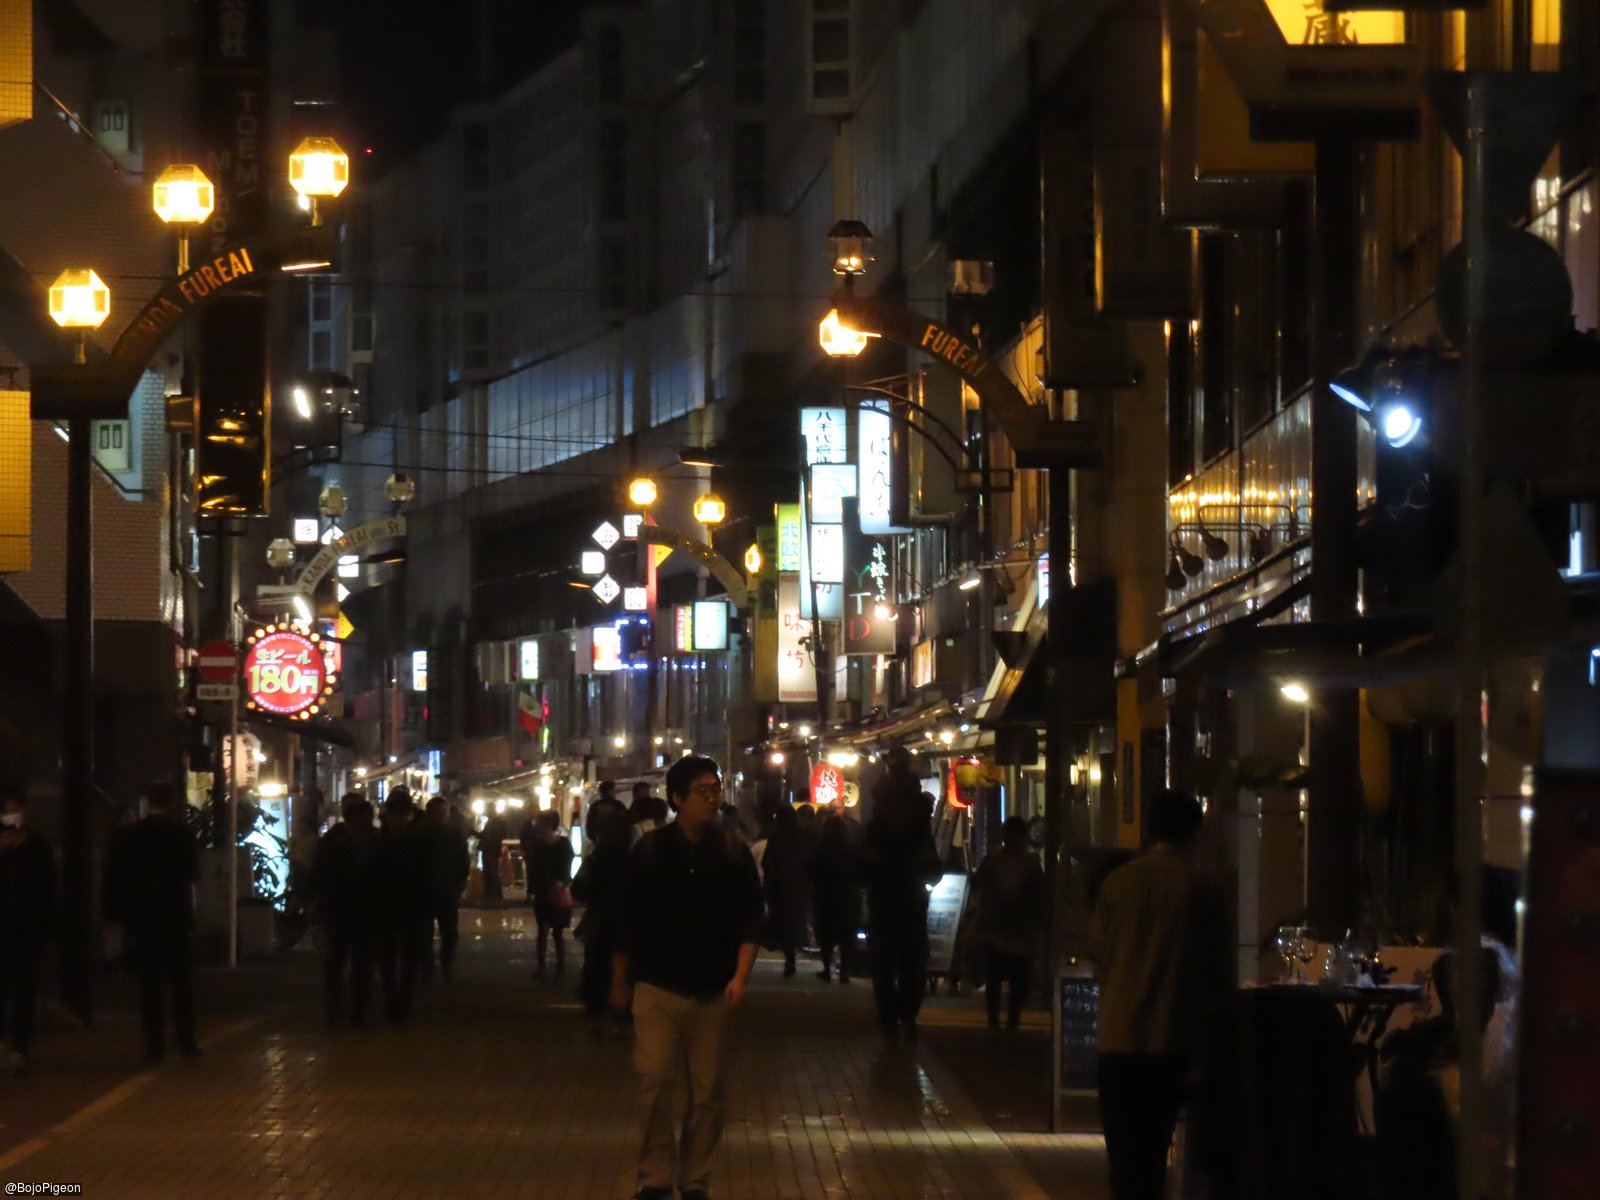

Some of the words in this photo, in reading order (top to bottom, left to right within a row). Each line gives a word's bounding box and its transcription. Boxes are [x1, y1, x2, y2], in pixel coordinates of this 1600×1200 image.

[178, 247, 254, 304] FUREAI
[255, 648, 312, 665] 生ビール
[249, 664, 319, 694] 180円
